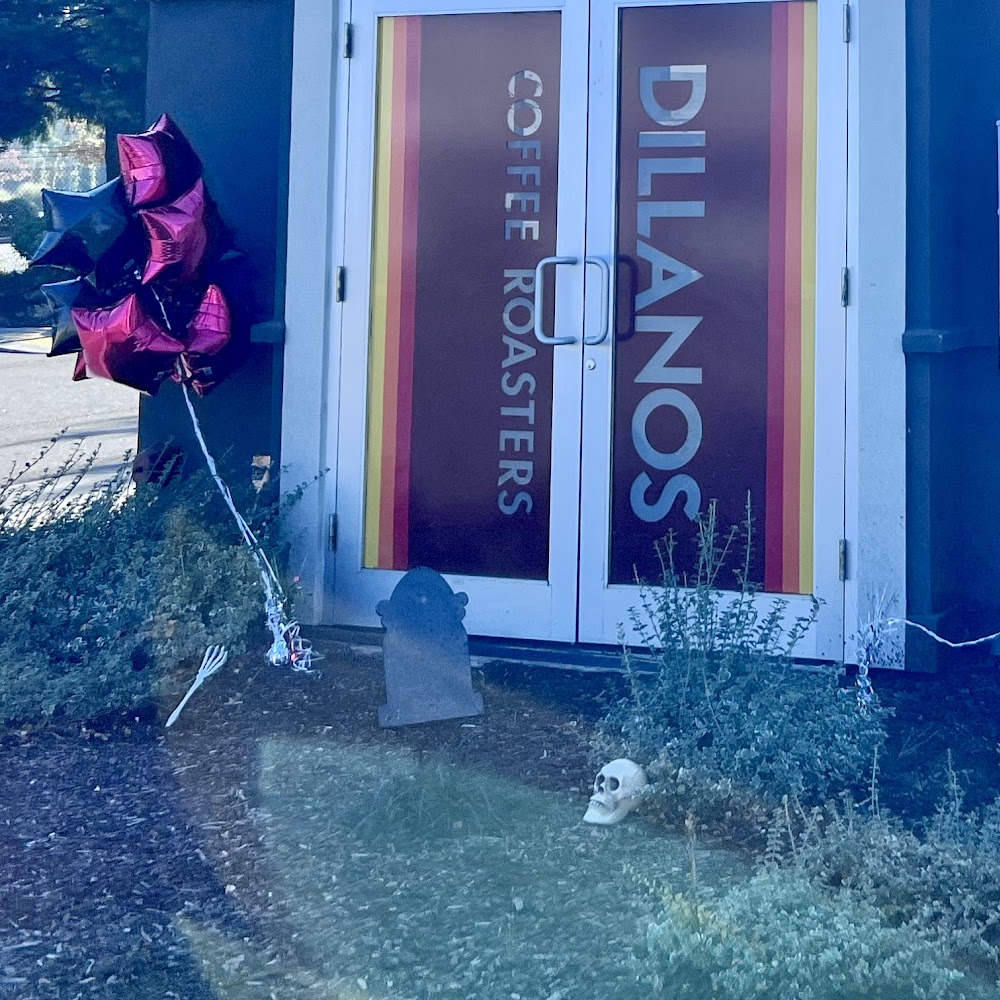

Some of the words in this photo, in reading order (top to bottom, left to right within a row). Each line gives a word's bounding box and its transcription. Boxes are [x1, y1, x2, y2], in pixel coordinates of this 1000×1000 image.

[504, 68, 544, 242] COFFEE
[498, 267, 537, 516] ROASTERS
[629, 64, 707, 522] DILLANOS
